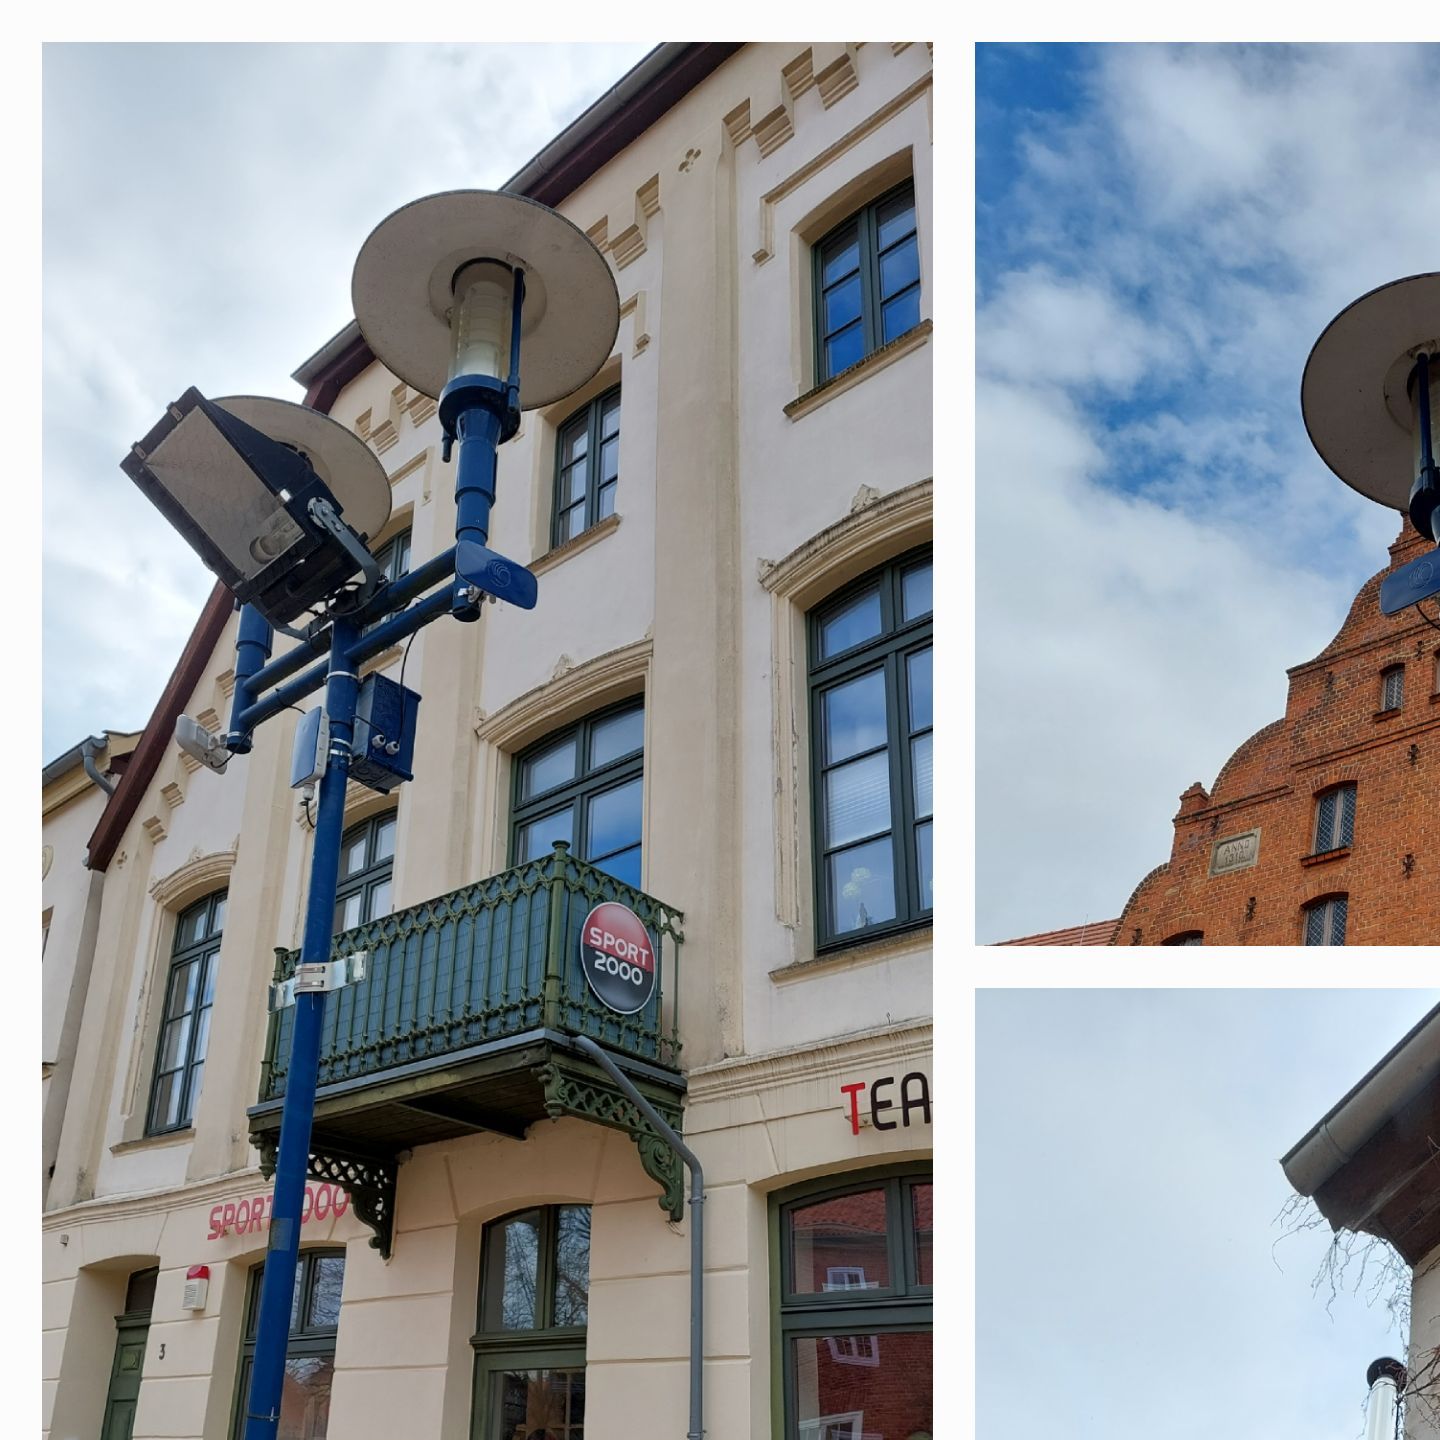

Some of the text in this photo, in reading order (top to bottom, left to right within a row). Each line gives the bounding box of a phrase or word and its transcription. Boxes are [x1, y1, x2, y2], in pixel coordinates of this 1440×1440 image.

[1224, 839, 1250, 855] ANNO
[589, 926, 650, 966] SPORT
[594, 951, 643, 985] 2000
[841, 1072, 931, 1136] TEA
[158, 1343, 166, 1360] 3
